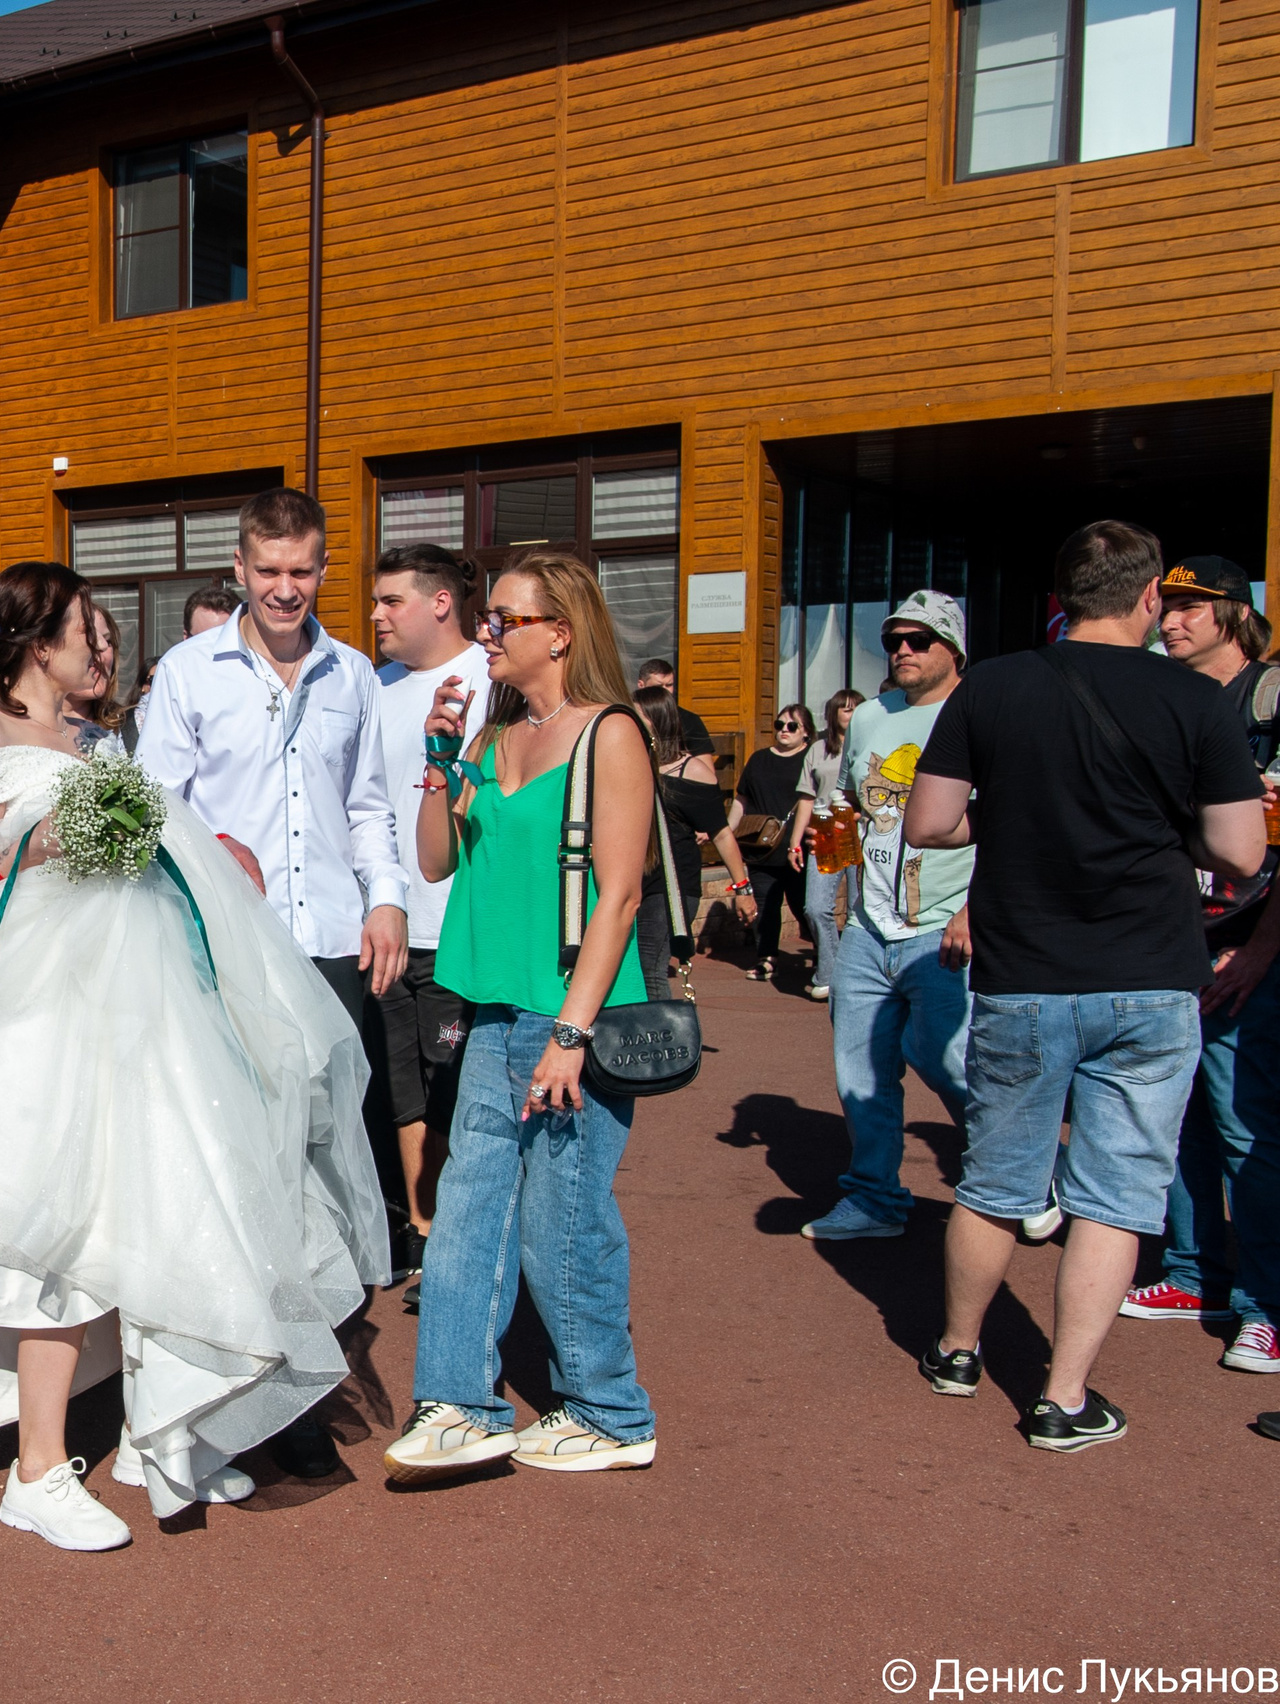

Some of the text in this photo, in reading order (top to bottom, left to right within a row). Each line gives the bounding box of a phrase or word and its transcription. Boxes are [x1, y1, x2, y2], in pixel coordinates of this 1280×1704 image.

[868, 848, 891, 865] YES!
[620, 1029, 673, 1048] MARC
[612, 1045, 690, 1067] JACOBS
